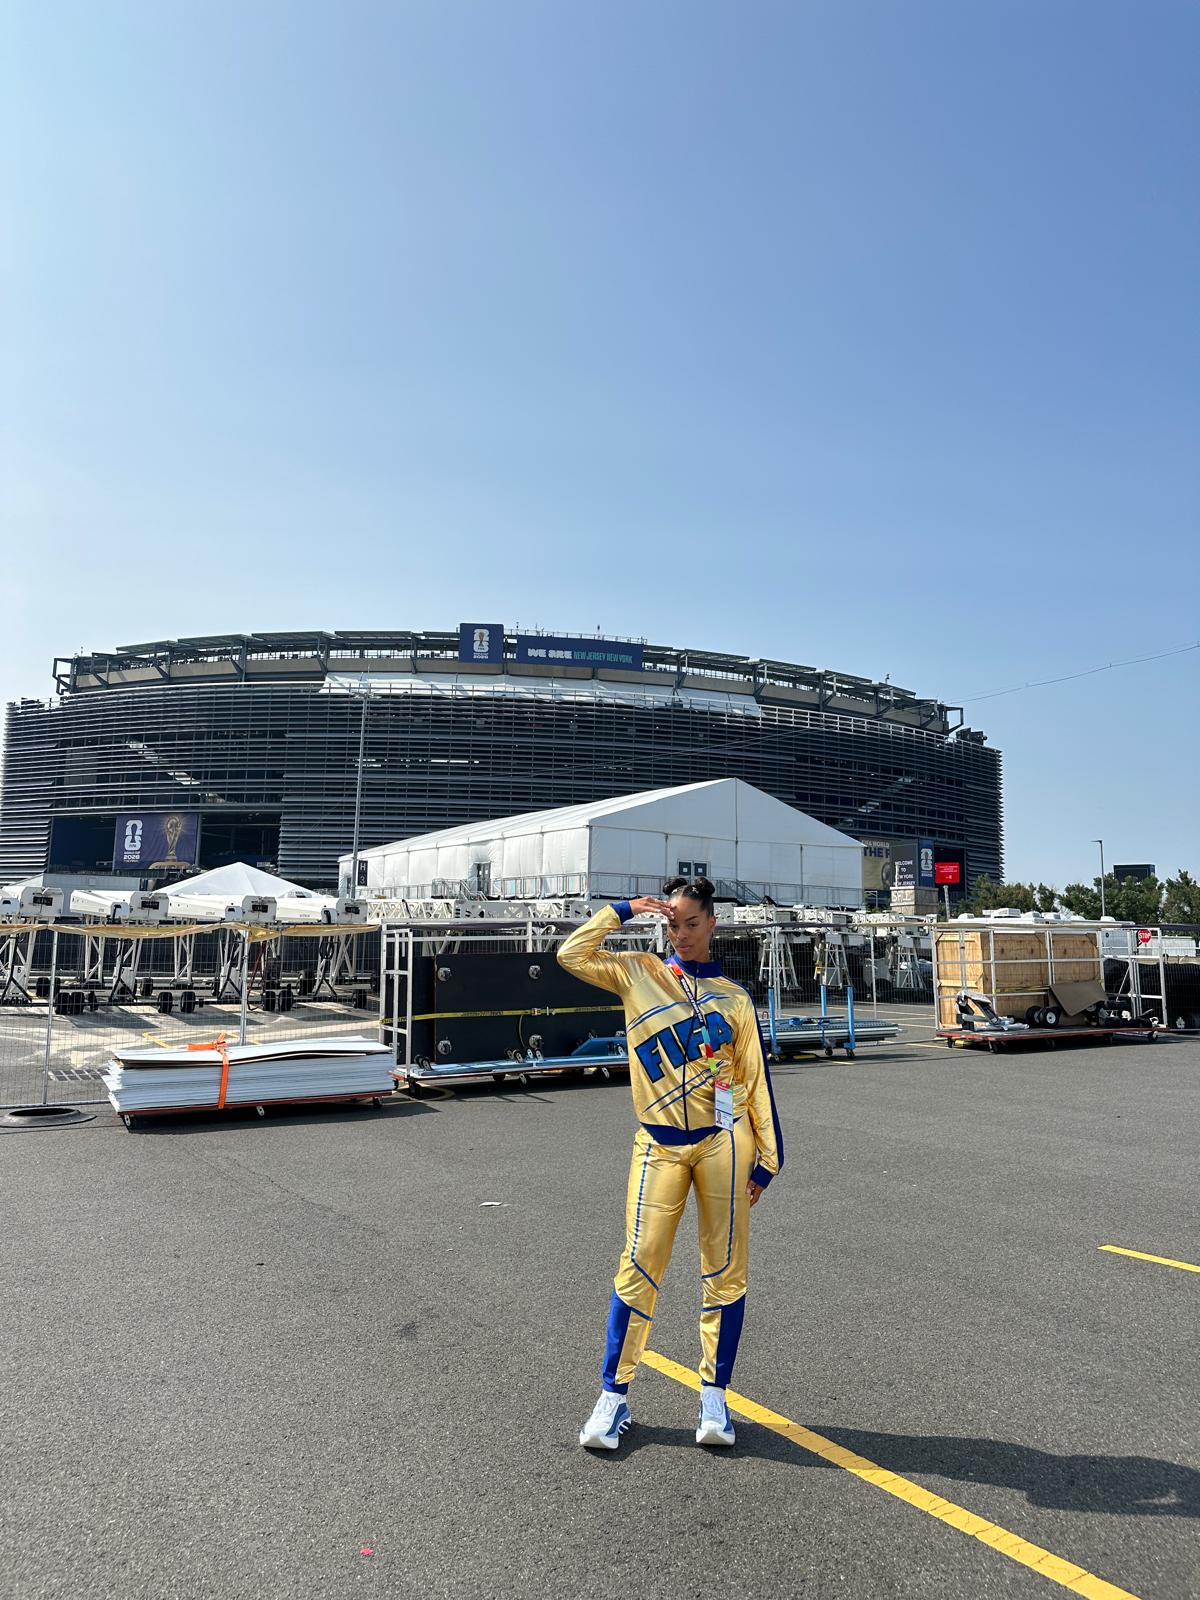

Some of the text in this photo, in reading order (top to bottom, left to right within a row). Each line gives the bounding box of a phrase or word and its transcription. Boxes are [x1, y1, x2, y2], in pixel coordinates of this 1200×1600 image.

[528, 648, 546, 658] WE
[573, 651, 586, 660] NEW
[586, 651, 606, 661] JERSEY
[864, 847, 884, 858] THE
[360, 863, 366, 871] H
[360, 875, 365, 884] 3
[634, 1011, 734, 1083] FIFA
